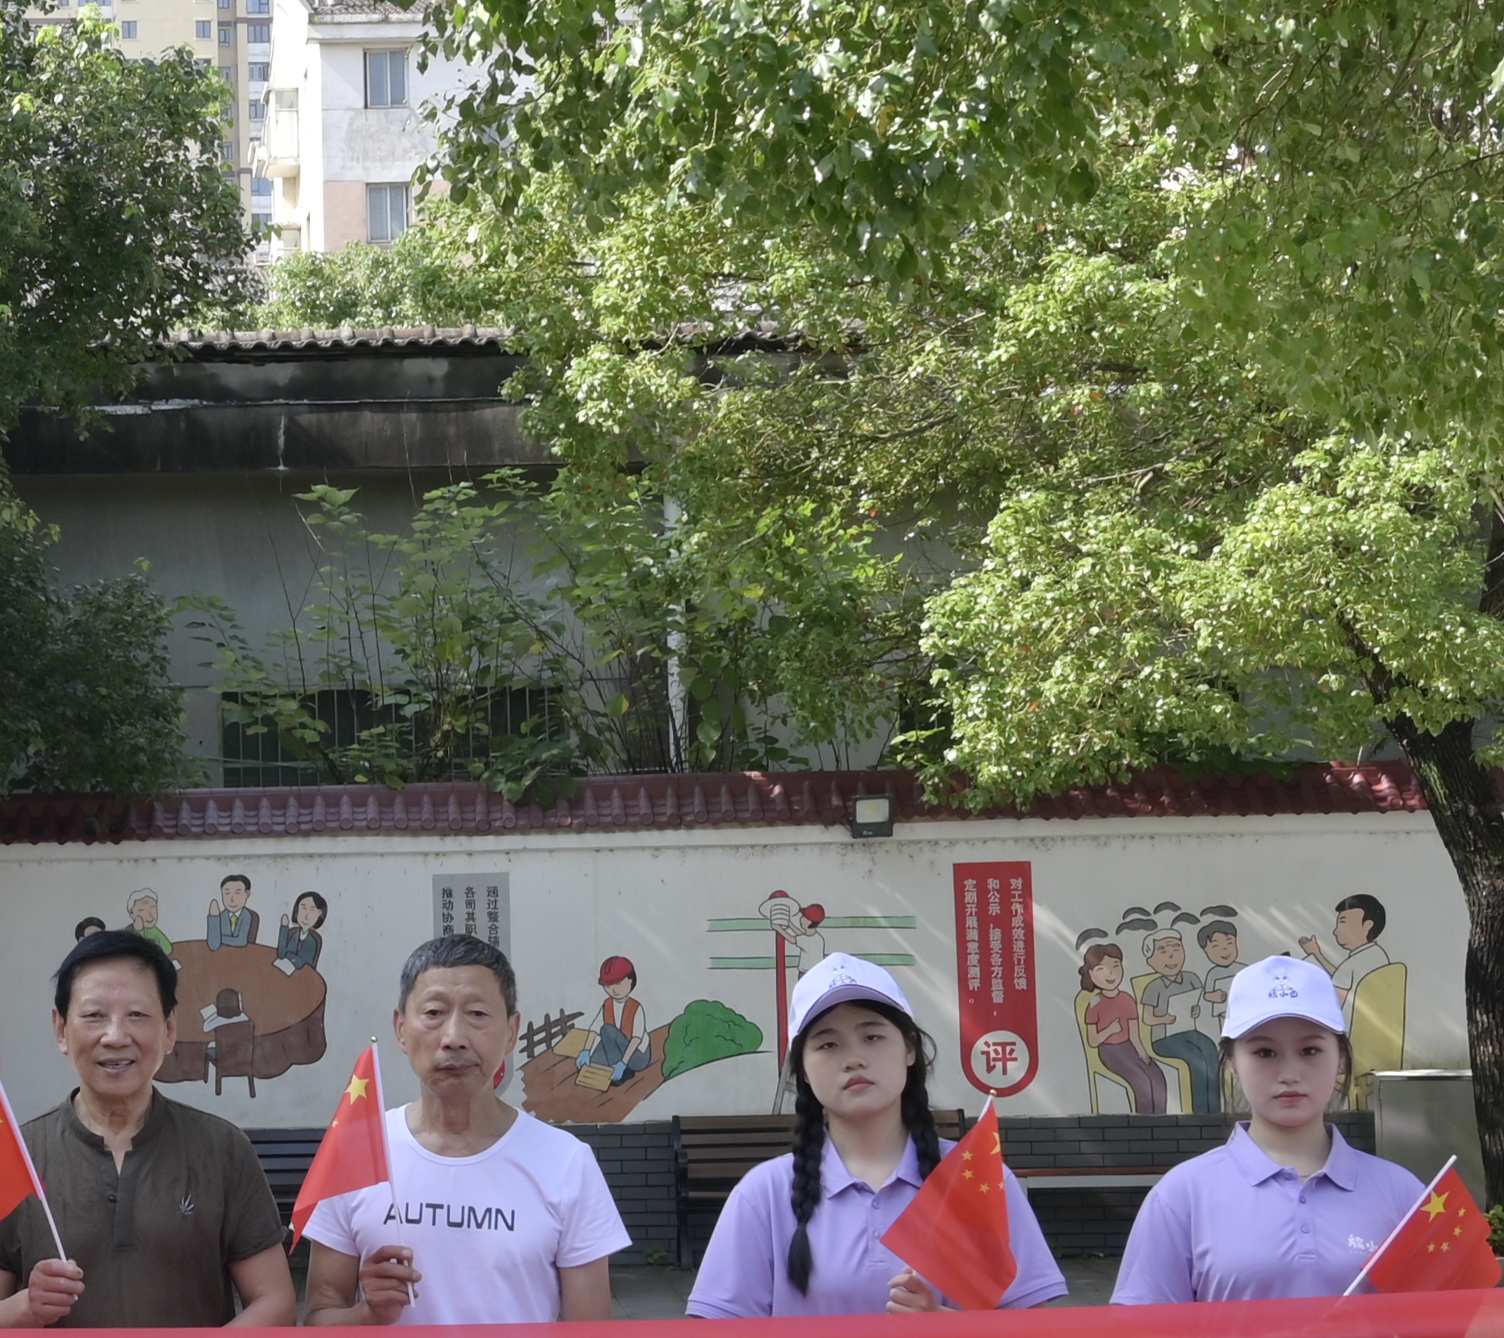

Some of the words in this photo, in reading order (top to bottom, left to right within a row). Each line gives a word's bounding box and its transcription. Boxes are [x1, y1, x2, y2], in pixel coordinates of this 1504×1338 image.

[1010, 877, 1028, 991] 对工作成效进行反馈
[980, 1040, 1019, 1076] 评
[382, 1202, 515, 1232] AUTUMN
